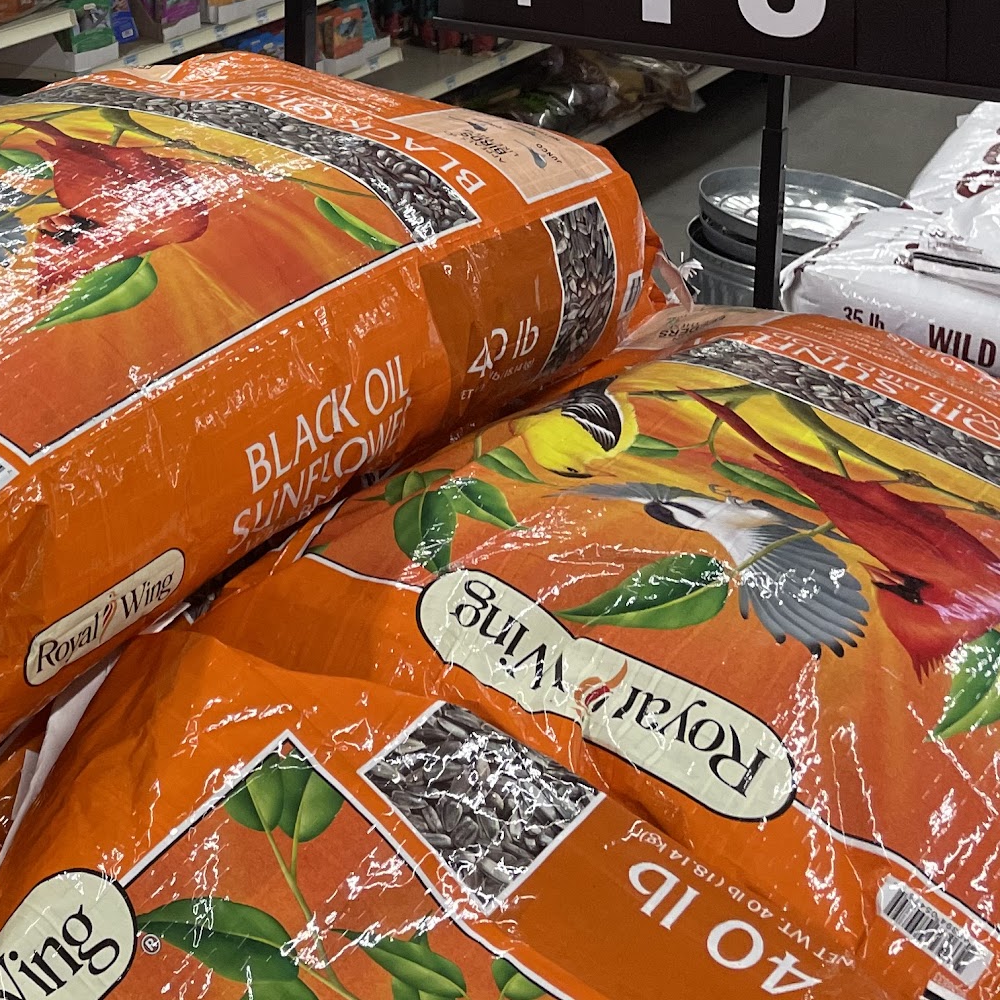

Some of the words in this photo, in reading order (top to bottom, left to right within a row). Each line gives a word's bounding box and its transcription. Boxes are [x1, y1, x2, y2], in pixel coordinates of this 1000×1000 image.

[344, 117, 488, 197] BLACK
[507, 315, 541, 356] lb
[928, 323, 997, 369] WILD
[246, 382, 355, 495] BLACK
[362, 353, 411, 419] OIL
[36, 611, 100, 673] Royal
[120, 567, 176, 620] Wing
[452, 578, 567, 693] Wing
[612, 685, 772, 798] Royal
[628, 860, 702, 933] lb
[726, 885, 750, 902] lb
[746, 896, 775, 921] 40
[705, 918, 823, 998] 40
[777, 921, 814, 952] WT.
